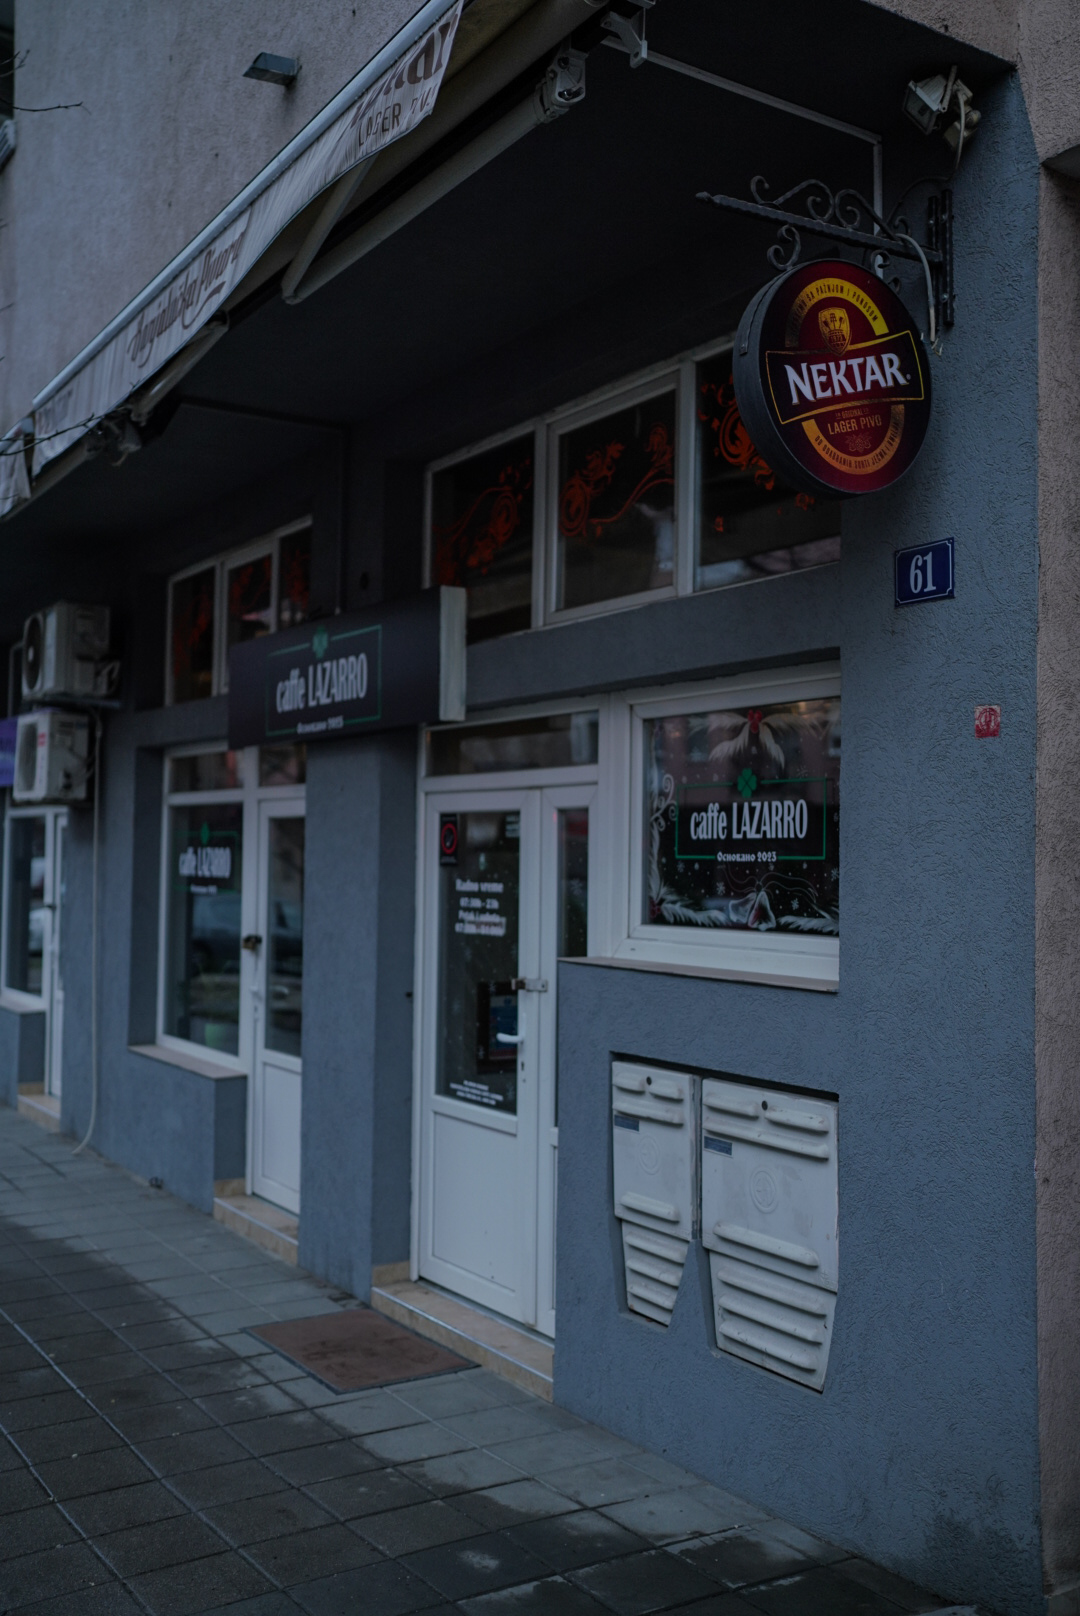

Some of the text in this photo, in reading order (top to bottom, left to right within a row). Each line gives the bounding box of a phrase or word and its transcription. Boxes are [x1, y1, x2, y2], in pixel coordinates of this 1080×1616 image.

[784, 352, 907, 406] NEKTAR
[827, 414, 883, 436] LAGER PIVO
[909, 552, 937, 594] 61
[276, 652, 369, 715] caffe LAZARRO
[690, 798, 809, 841] caffe LAZARRO
[717, 851, 756, 862] Основано
